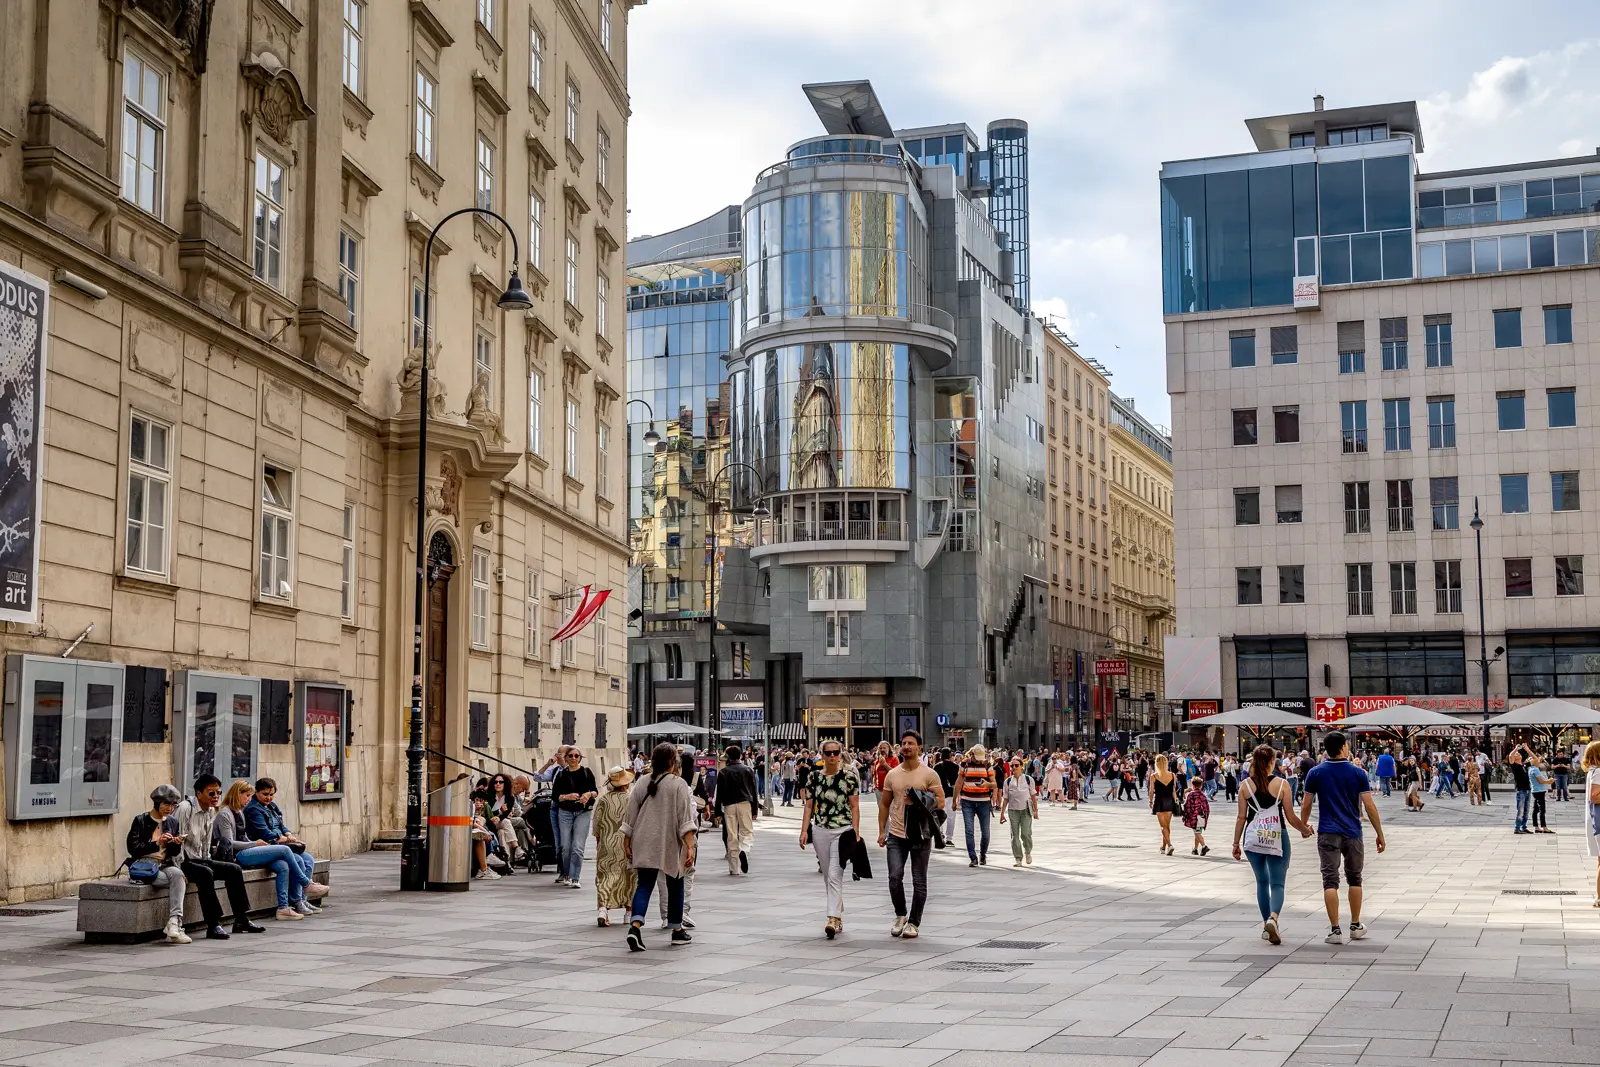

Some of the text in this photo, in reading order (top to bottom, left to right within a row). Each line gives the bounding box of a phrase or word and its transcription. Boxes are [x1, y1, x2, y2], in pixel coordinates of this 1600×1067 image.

[5, 586, 27, 605] art
[733, 693, 749, 701] ZARA
[937, 716, 946, 726] U
[1424, 729, 1483, 737] SOUVENIR
[31, 798, 57, 806] SAMSUNG
[1257, 830, 1281, 839] STADT
[1258, 837, 1274, 845] Wien
